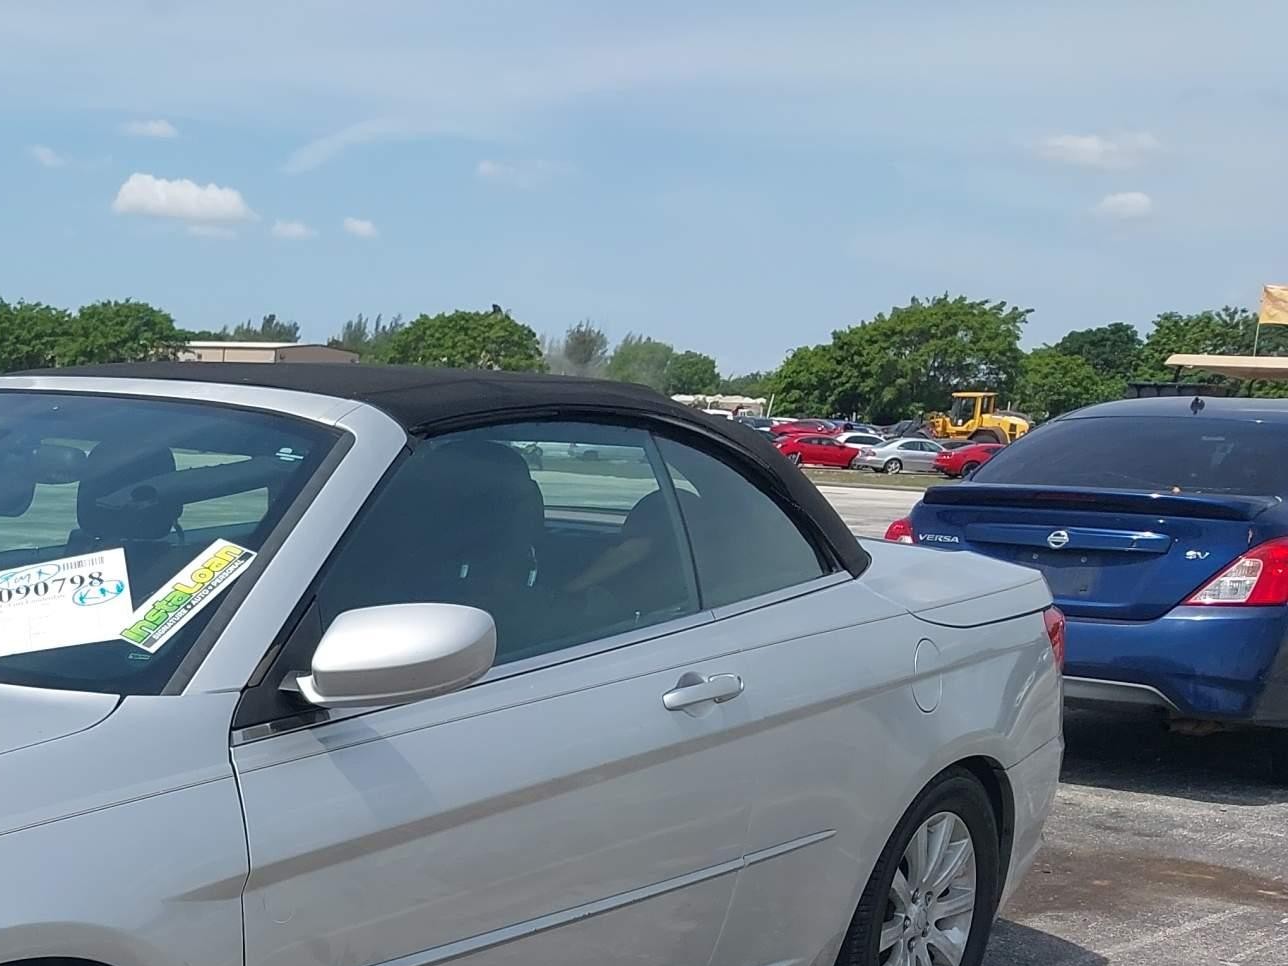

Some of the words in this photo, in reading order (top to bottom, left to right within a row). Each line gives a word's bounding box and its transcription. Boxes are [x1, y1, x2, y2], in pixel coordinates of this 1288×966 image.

[918, 533, 960, 544] VERSA
[1185, 550, 1210, 560] SV
[120, 545, 245, 644] InstaLoan
[152, 609, 188, 640] SIGNATURE
[191, 588, 210, 606] AUTO
[212, 559, 245, 587] PERSONAL
